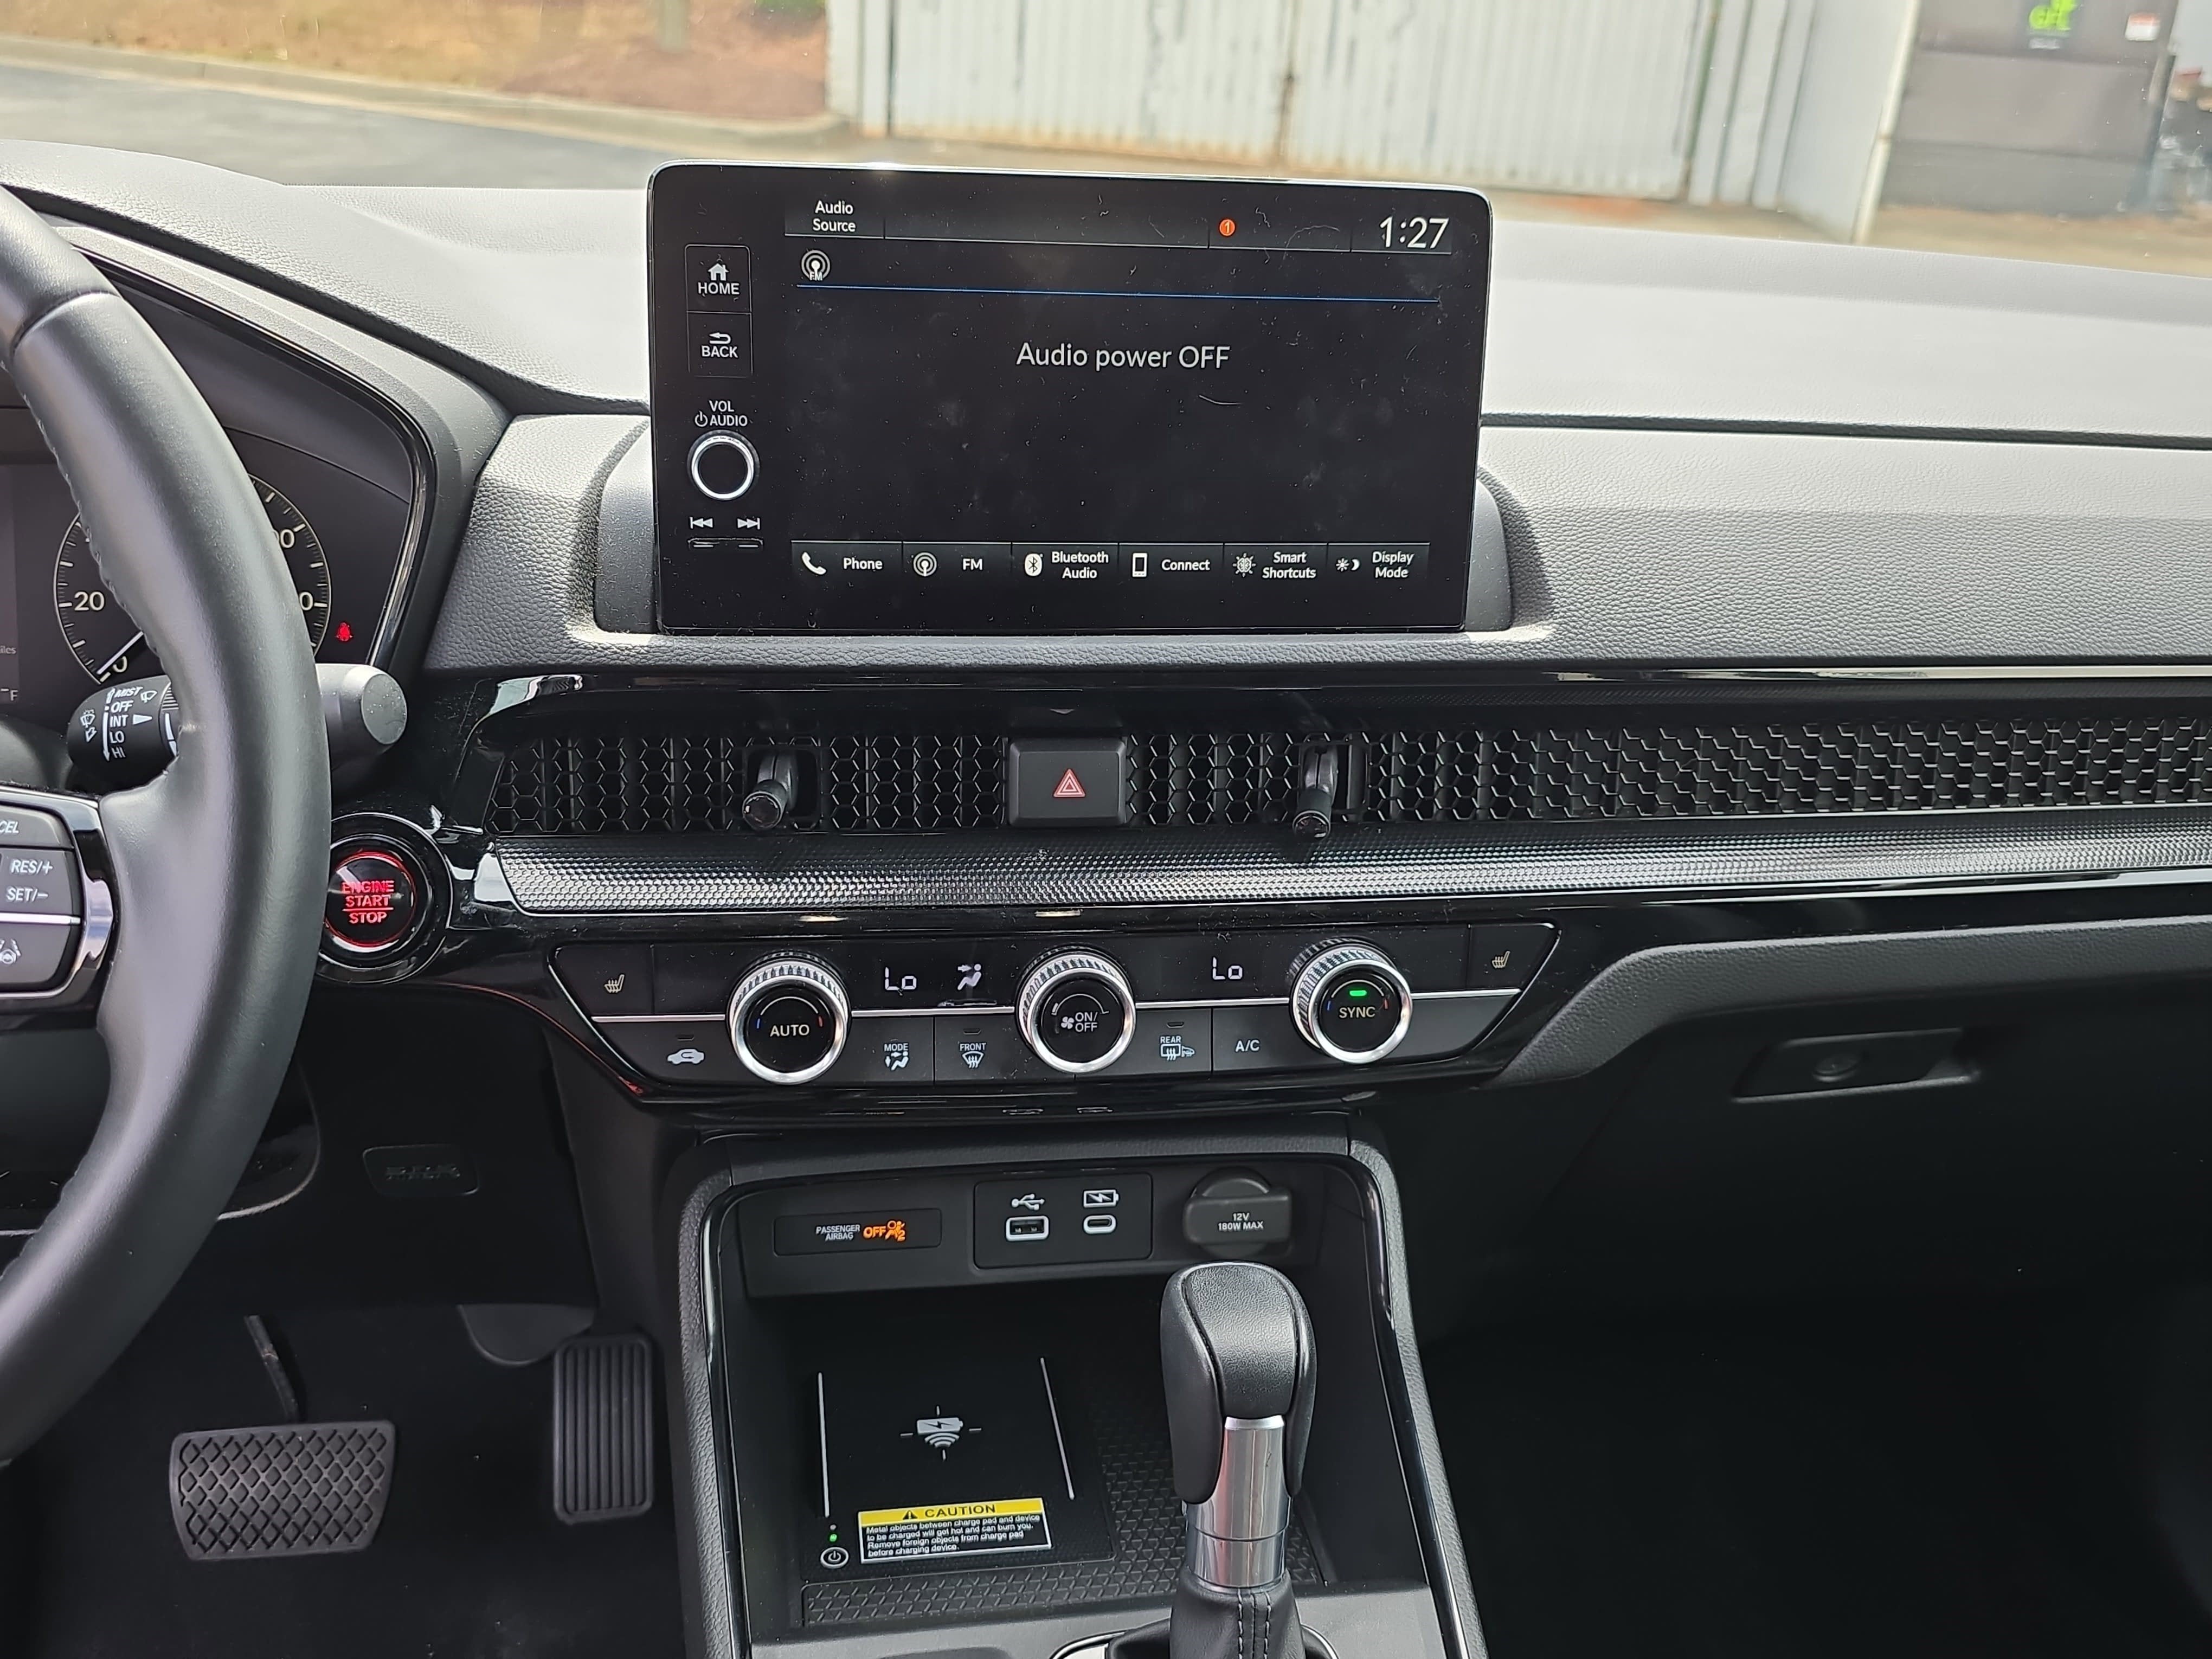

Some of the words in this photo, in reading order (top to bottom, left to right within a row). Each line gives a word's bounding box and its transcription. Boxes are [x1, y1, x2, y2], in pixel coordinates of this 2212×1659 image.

[815, 200, 853, 215] Audio
[813, 218, 856, 233] Source
[1380, 216, 1449, 248] 1:27
[698, 282, 740, 295] HOME
[702, 346, 738, 358] BACK
[1016, 342, 1088, 366] Audio
[1096, 348, 1172, 371] power
[1179, 345, 1230, 369] OFF
[709, 400, 735, 413] VOL
[710, 414, 748, 427] AUDIO
[843, 556, 883, 570] Phone
[1052, 550, 1109, 564] Bluetooth
[1273, 551, 1307, 563] Smart
[1372, 551, 1414, 565] Display
[962, 558, 983, 571] FM
[1161, 558, 1210, 571] Connect
[1062, 567, 1097, 579] Audio
[1262, 566, 1316, 578] Shortcuts
[1375, 566, 1409, 578] Mode
[74, 591, 105, 610] 20
[10, 690, 18, 701] F
[114, 687, 143, 698] MIST
[111, 700, 133, 713] OFF
[110, 715, 128, 727] INT
[110, 730, 125, 743] LO
[111, 748, 126, 758] HI
[342, 880, 394, 893] ENGINE
[345, 895, 391, 907] START
[349, 912, 387, 924] STOP
[1075, 1012, 1098, 1023] ON/
[1339, 1006, 1375, 1019] SYNC
[770, 1024, 809, 1037] AUTO
[1075, 1022, 1098, 1032] OFF
[1160, 1036, 1181, 1044] REAR
[1235, 1039, 1260, 1052] A/C
[884, 1042, 908, 1051] MODE
[959, 1042, 986, 1051] FRONT
[1233, 1213, 1250, 1221] 12V
[816, 1224, 860, 1234] PASSENGER
[863, 1226, 886, 1238] OFF
[1218, 1222, 1241, 1231] 180W
[1243, 1221, 1264, 1230] MAX
[820, 1232, 854, 1242] AIRBAG
[924, 1504, 996, 1517] CAUTION
[982, 1516, 997, 1525] pad
[965, 1526, 980, 1534] and
